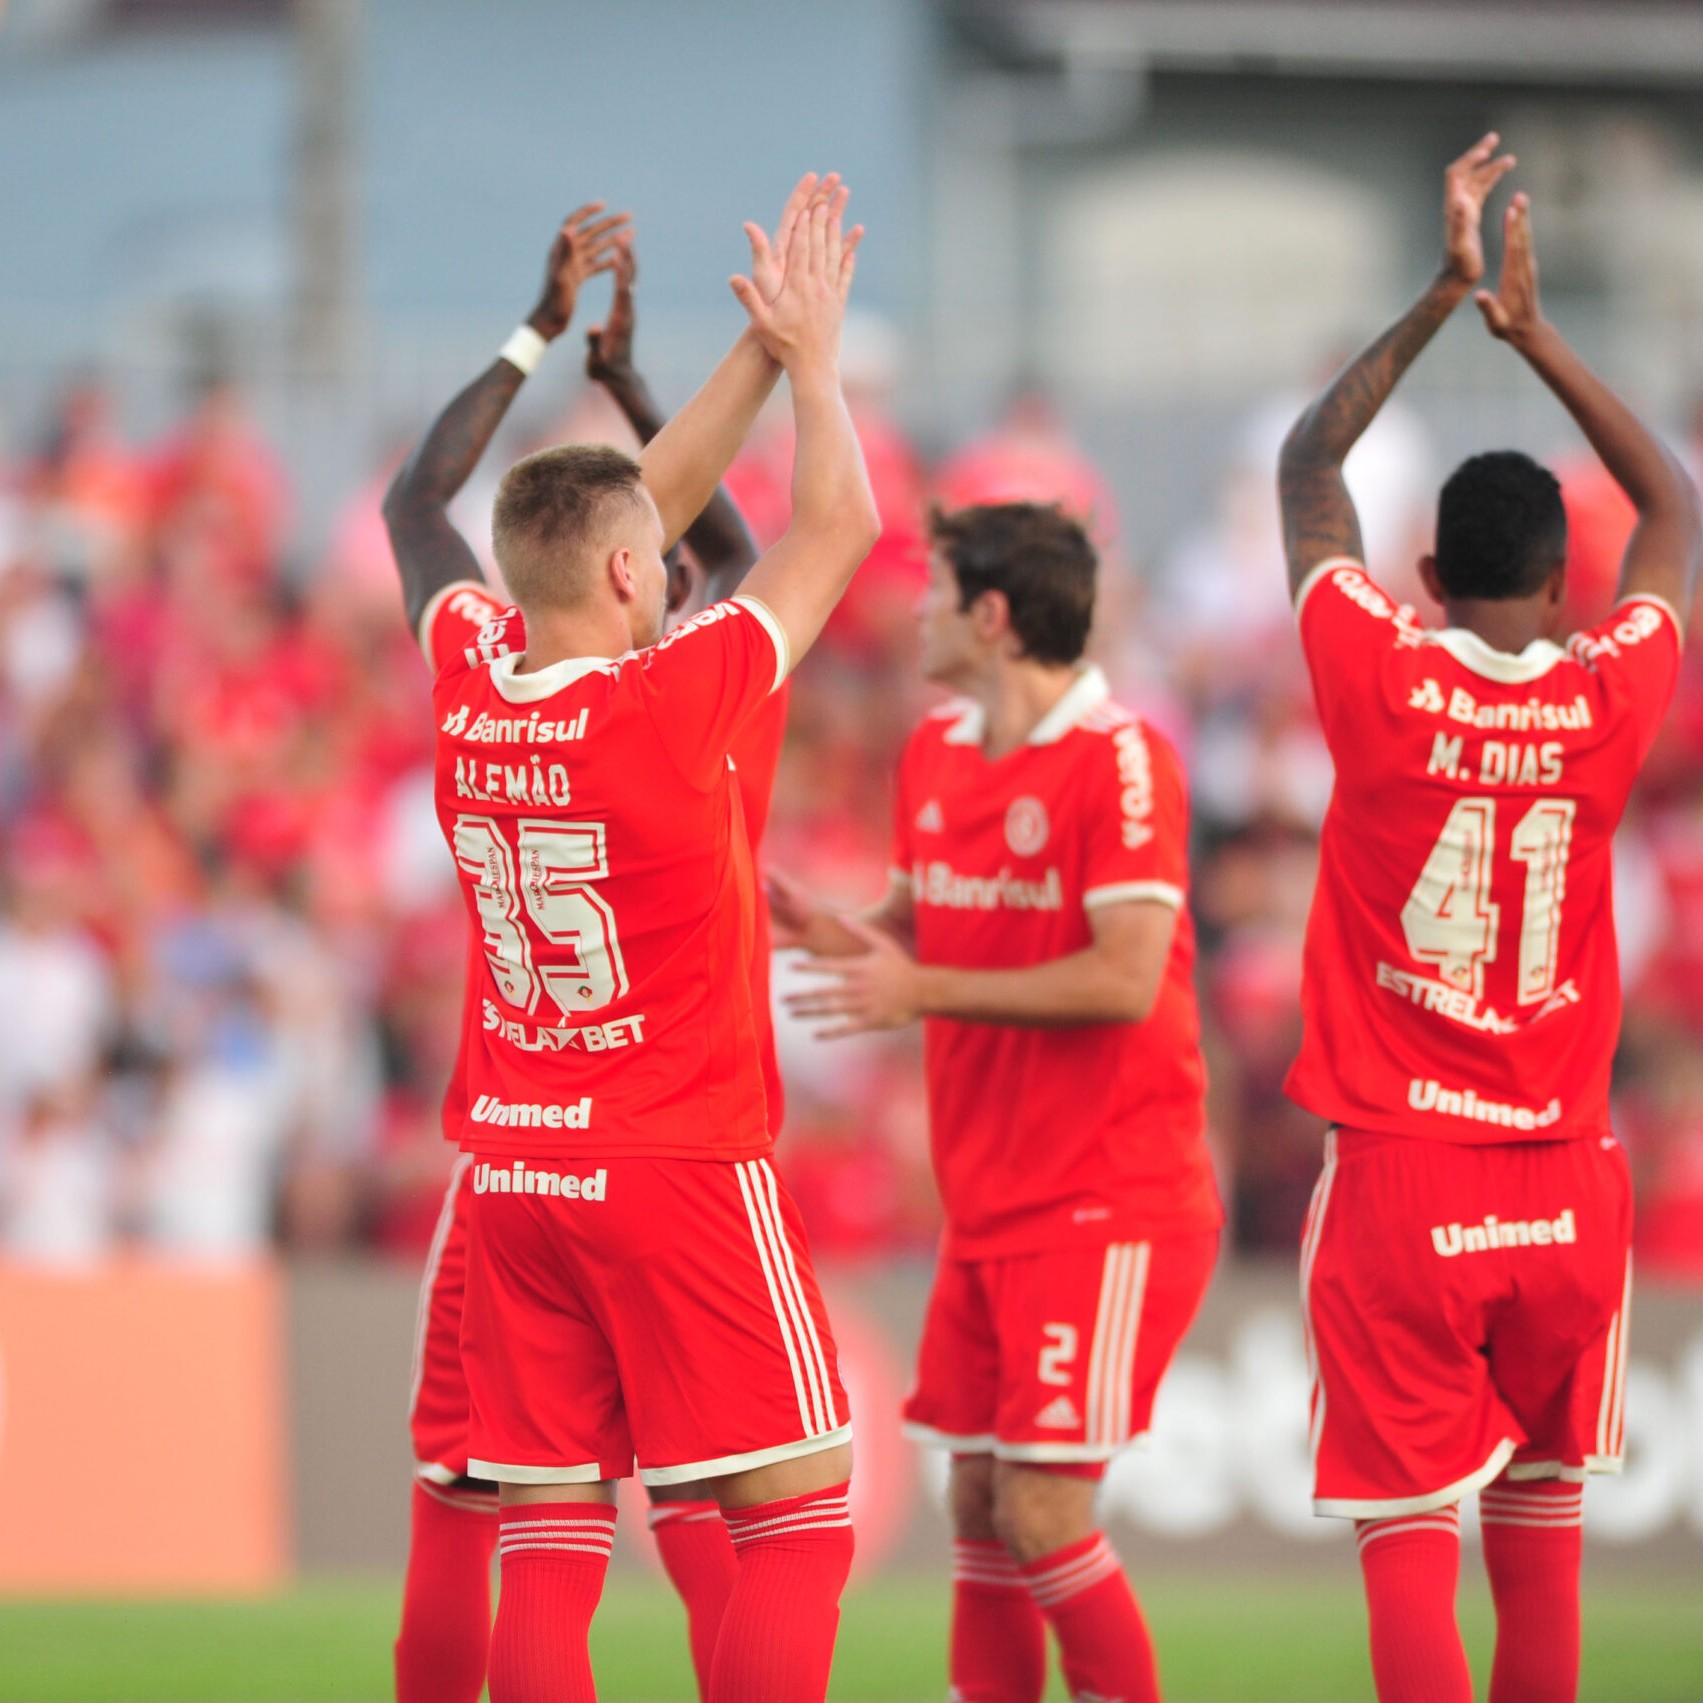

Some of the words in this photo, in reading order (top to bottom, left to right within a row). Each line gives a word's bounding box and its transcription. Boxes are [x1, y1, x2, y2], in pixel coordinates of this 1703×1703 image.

[467, 708, 590, 744] Banrisul
[1447, 687, 1592, 731] Banrisul
[454, 754, 571, 807] ALEMÃO
[1427, 731, 1470, 781] M.
[1479, 741, 1564, 785] DIAS
[926, 861, 1063, 911] Banrisul
[1400, 797, 1580, 1006] 41
[452, 813, 630, 1018] 35
[1408, 1078, 1561, 1130] Unimed
[473, 1160, 608, 1202] Unimed
[1431, 1209, 1577, 1257] Unimed
[1038, 1323, 1077, 1386] 2
